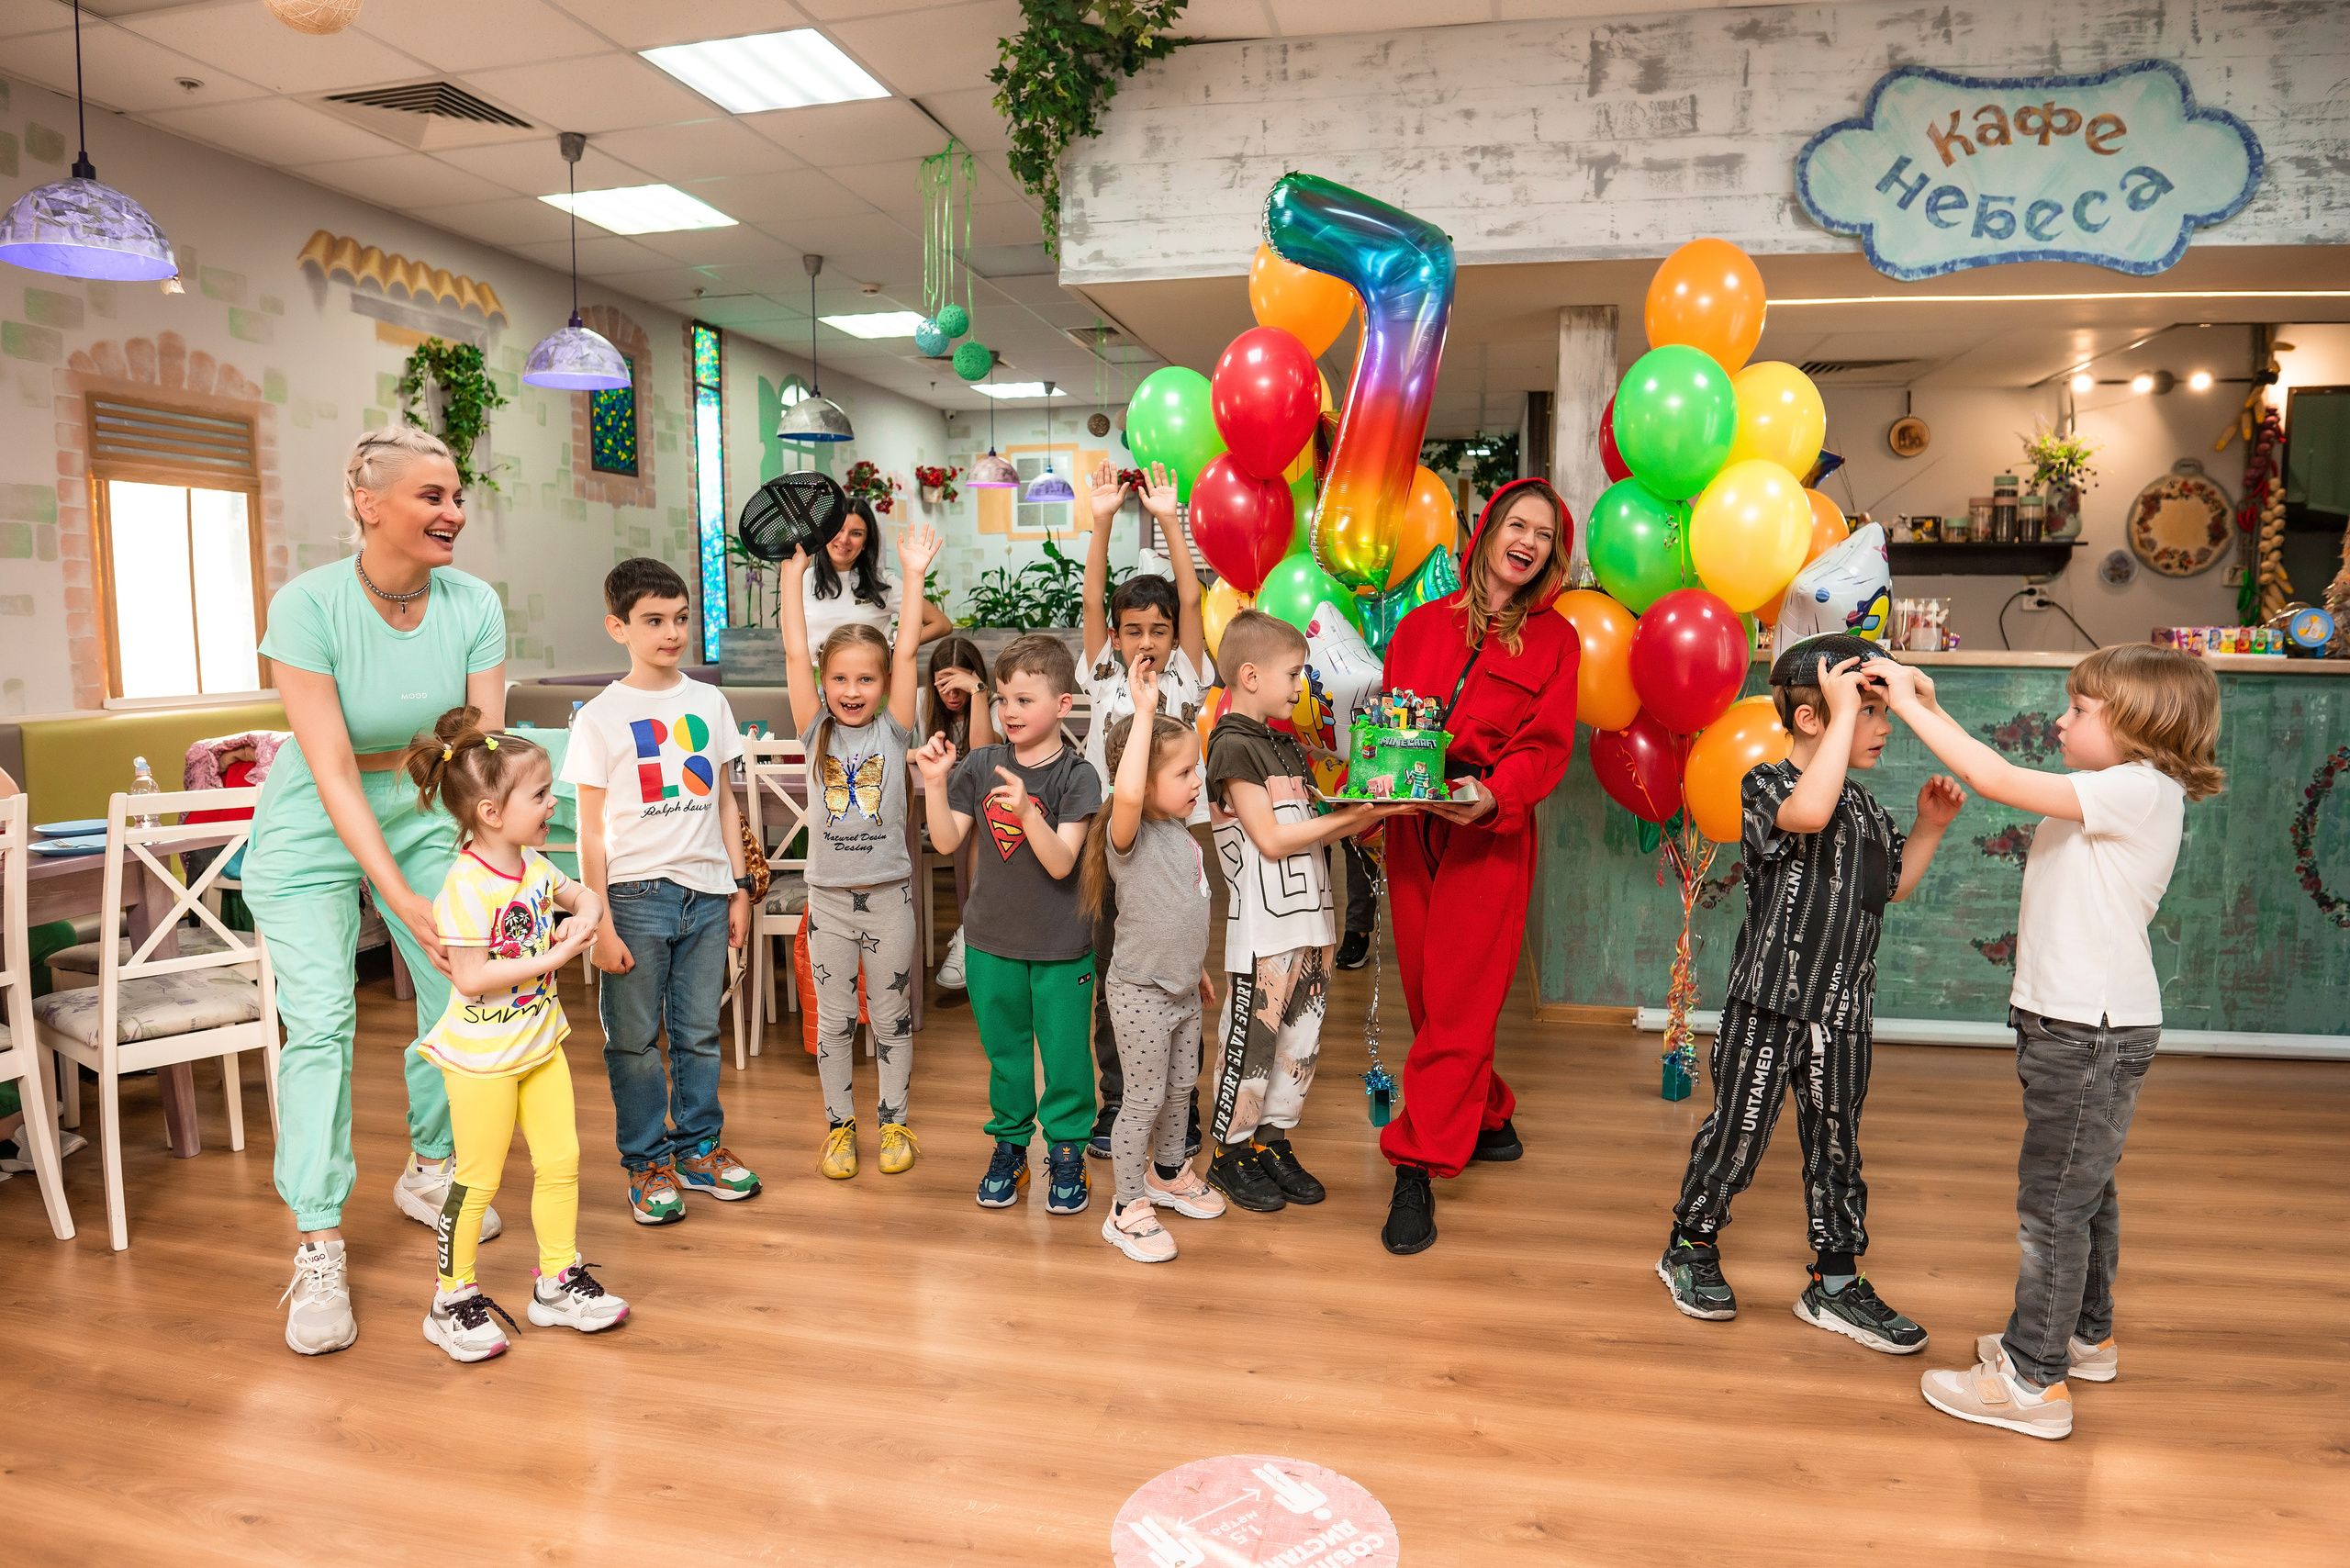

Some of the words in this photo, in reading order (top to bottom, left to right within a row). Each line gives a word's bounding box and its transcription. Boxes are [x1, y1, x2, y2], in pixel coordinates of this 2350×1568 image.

[1262, 172, 1457, 592] 7
[1380, 737, 1437, 750] MINECRAFT
[640, 801, 681, 819] Ralph
[822, 832, 859, 842] Naturel
[859, 833, 888, 841] Desin
[834, 842, 874, 855] Desing
[1828, 962, 1843, 994] GLVR
[1234, 977, 1252, 1027] SPORT
[1227, 1025, 1247, 1068] GLVR
[1744, 1016, 1758, 1047] GLVR
[1219, 1066, 1240, 1114] SPORT
[1740, 1046, 1774, 1132] UNTAMED
[438, 1213, 453, 1269] GLVR
[1210, 1510, 1259, 1537] метра
[1229, 1524, 1263, 1546] 1,5
[1255, 1518, 1360, 1568] ДИСТАН
